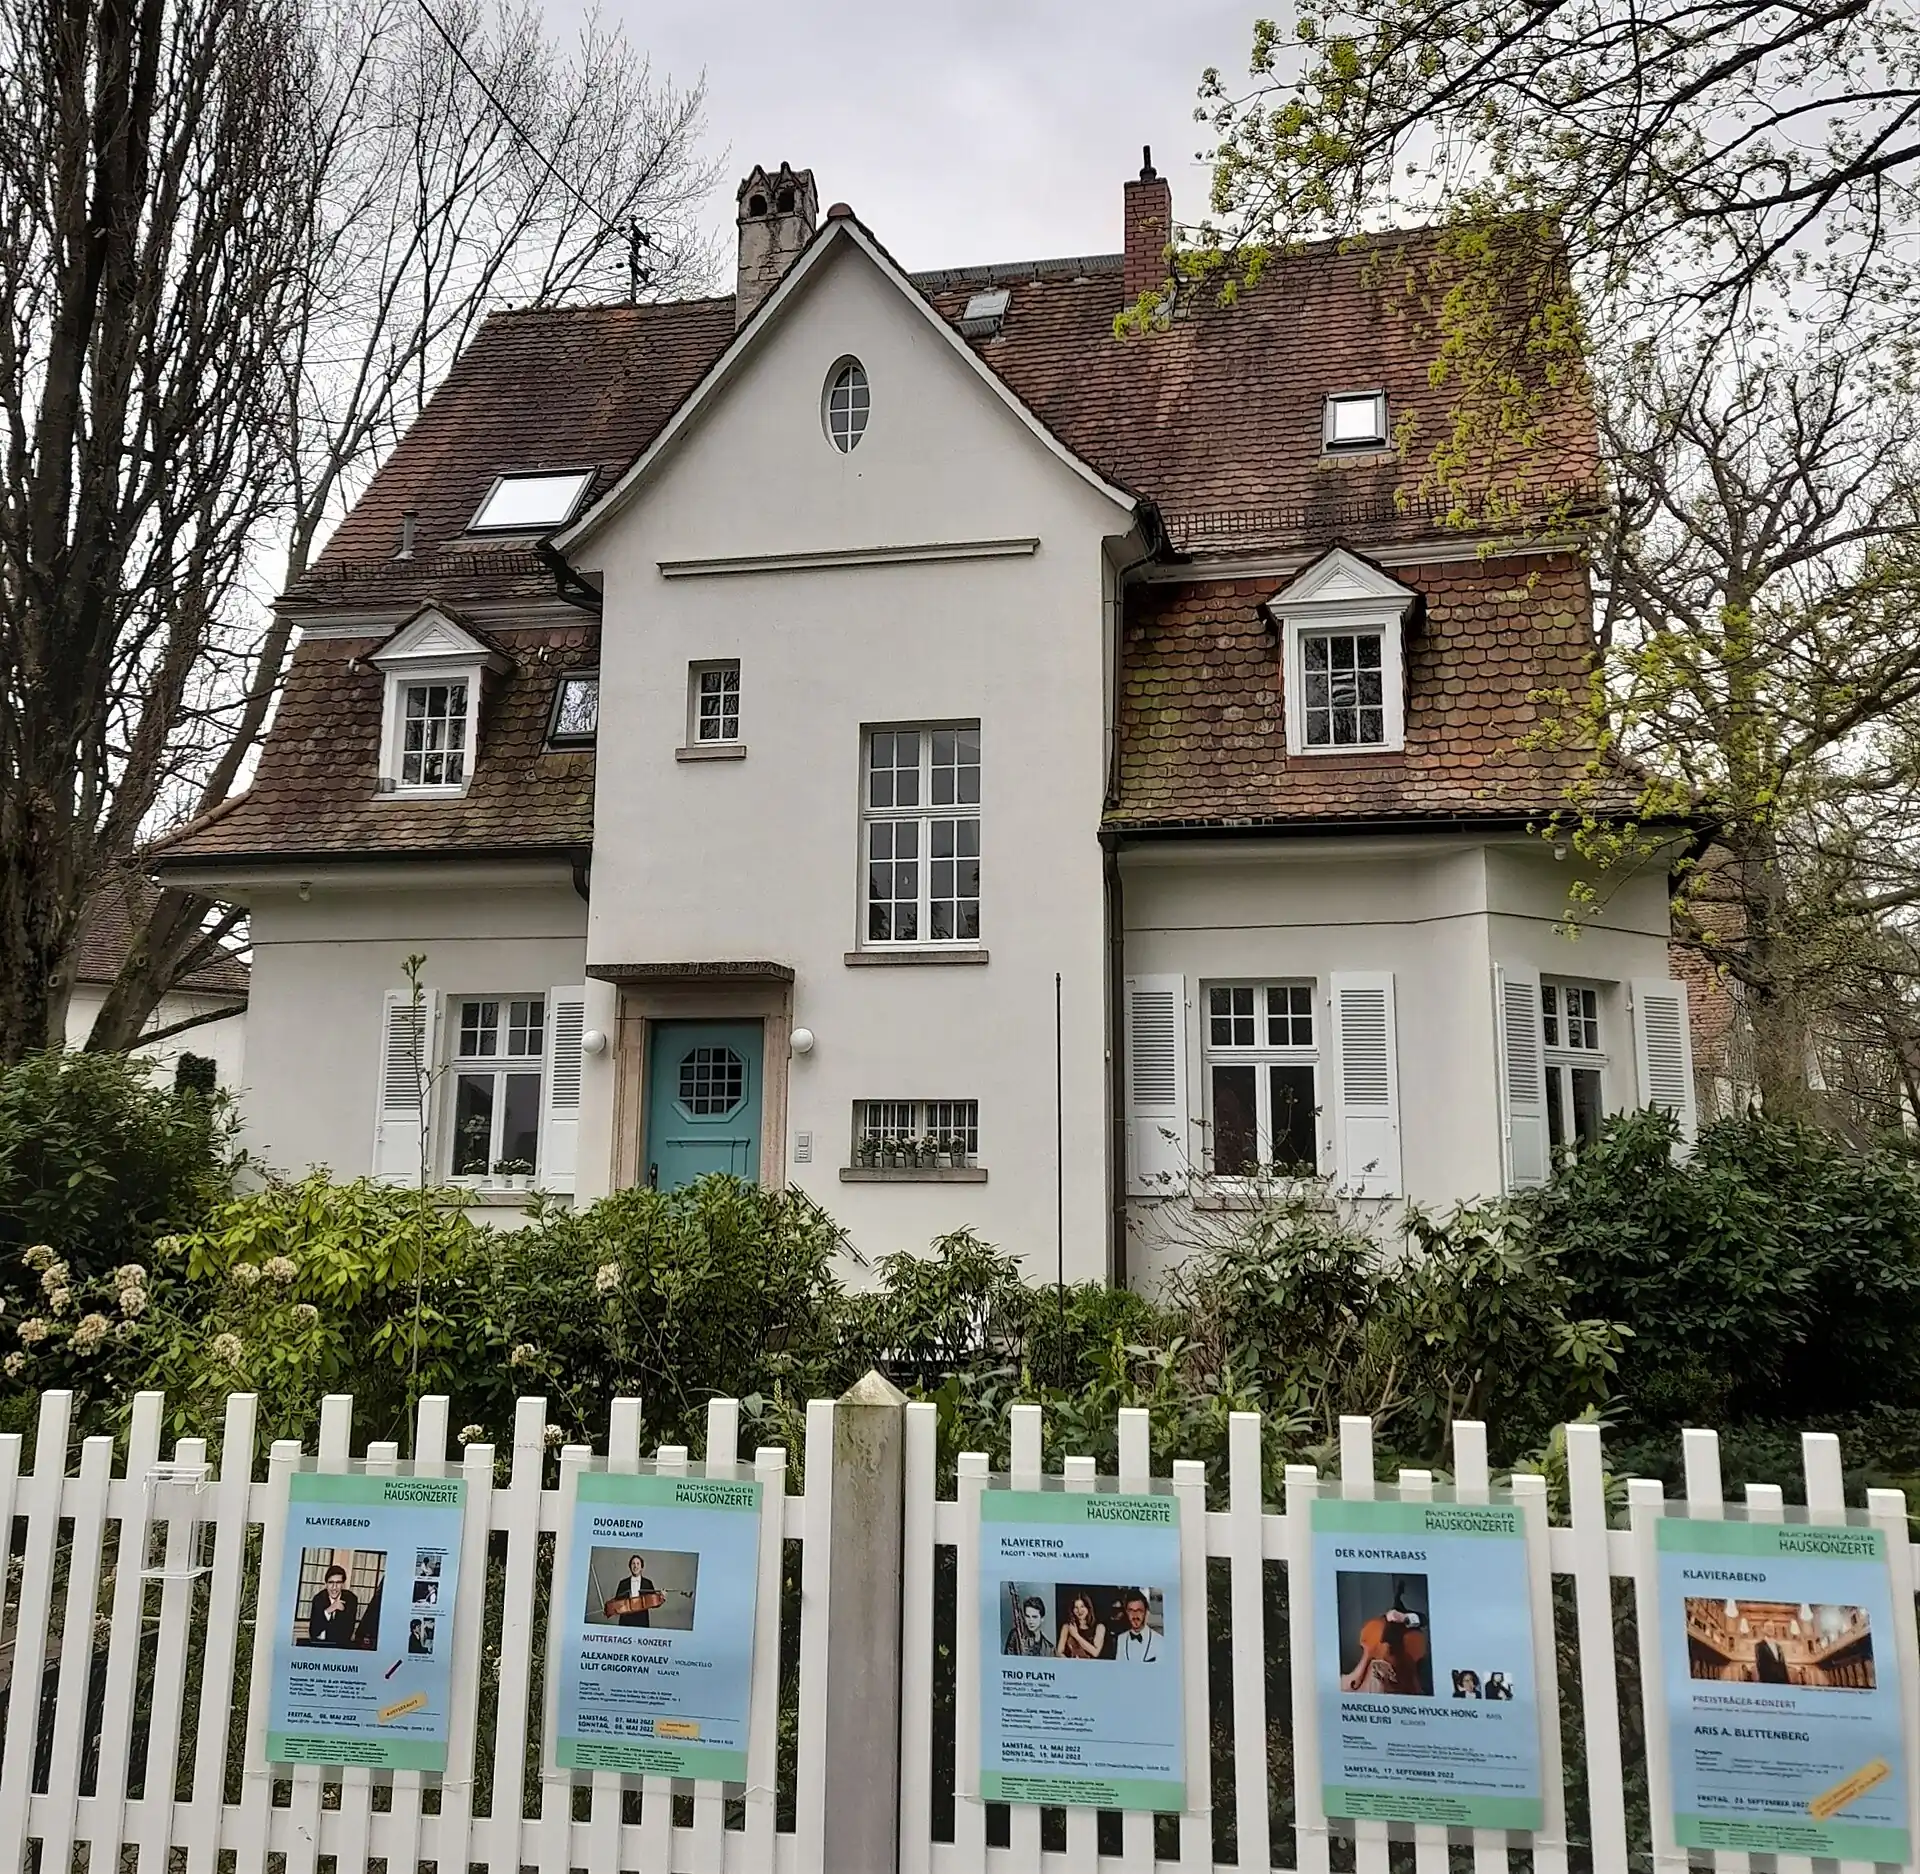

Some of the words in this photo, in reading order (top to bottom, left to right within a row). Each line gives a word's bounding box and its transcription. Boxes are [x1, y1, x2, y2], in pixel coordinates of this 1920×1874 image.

[385, 1482, 458, 1490] BUCHSCHLAGER
[677, 1483, 753, 1493] BUCHSCHLAGER
[384, 1489, 457, 1503] HAUSKONZERTE
[676, 1491, 753, 1506] HAUSKONZERTE
[1087, 1500, 1170, 1509] BUCHSCHLAGER
[1087, 1507, 1170, 1522] HAUSKONZERTE
[1425, 1510, 1514, 1519] BUCHSCHLAGER
[305, 1516, 371, 1528] KLAVIERABEND
[593, 1517, 644, 1529] DUOABEND
[1425, 1518, 1515, 1533] HAUSKONZERTE
[593, 1529, 611, 1537] CELLO
[618, 1530, 643, 1538] KLAVIER
[1779, 1531, 1874, 1541] BUCHSCHLAGER
[1001, 1537, 1064, 1549] KLAVIERTRIO
[1779, 1540, 1875, 1555] HAUSKONZERTE
[1032, 1551, 1057, 1559] VIOLINE
[1335, 1549, 1355, 1558] DER
[1358, 1549, 1427, 1560] KONTRABASS
[1682, 1569, 1767, 1582] KLAVIERABEND
[582, 1634, 632, 1645] MUTTERTAGS
[637, 1637, 672, 1648] KONZERT
[581, 1651, 631, 1662] ALEXANDER
[631, 1654, 669, 1665] KOVALEV
[290, 1661, 320, 1671] NURON
[322, 1663, 359, 1673] MUKUMI
[580, 1662, 600, 1671] LILIT
[601, 1663, 649, 1674] GRIGORYAN
[1002, 1670, 1023, 1679] TRIO
[1025, 1671, 1055, 1681] PLATH
[1341, 1703, 1390, 1713] MARCELLO
[1391, 1705, 1417, 1715] SUNG
[1418, 1706, 1449, 1717] HYUCK
[1450, 1709, 1478, 1719] HONG
[1342, 1714, 1367, 1723] NAMI
[1694, 1726, 1718, 1736] ARIS
[1734, 1728, 1810, 1741] BLETTENBERG
